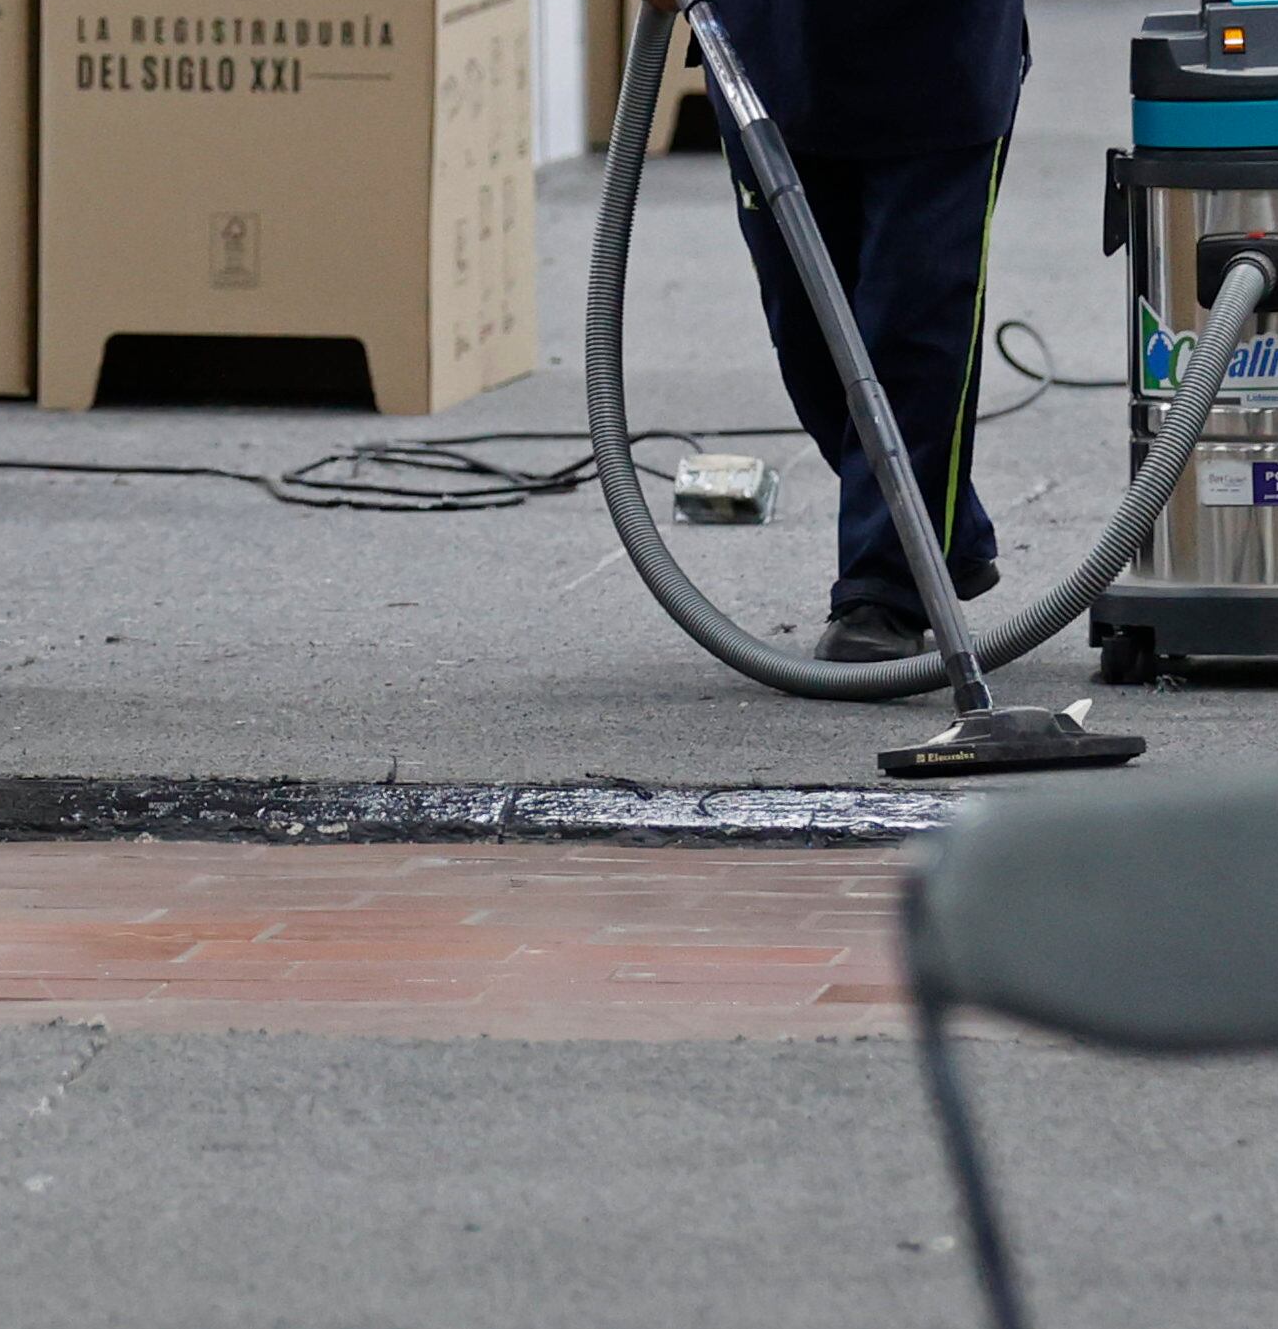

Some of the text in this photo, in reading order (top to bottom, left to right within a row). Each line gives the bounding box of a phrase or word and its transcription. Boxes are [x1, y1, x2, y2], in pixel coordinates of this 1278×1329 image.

[77, 16, 394, 47] LA REGISTRADURÍA
[77, 54, 301, 93] DEL SIGLO XXI
